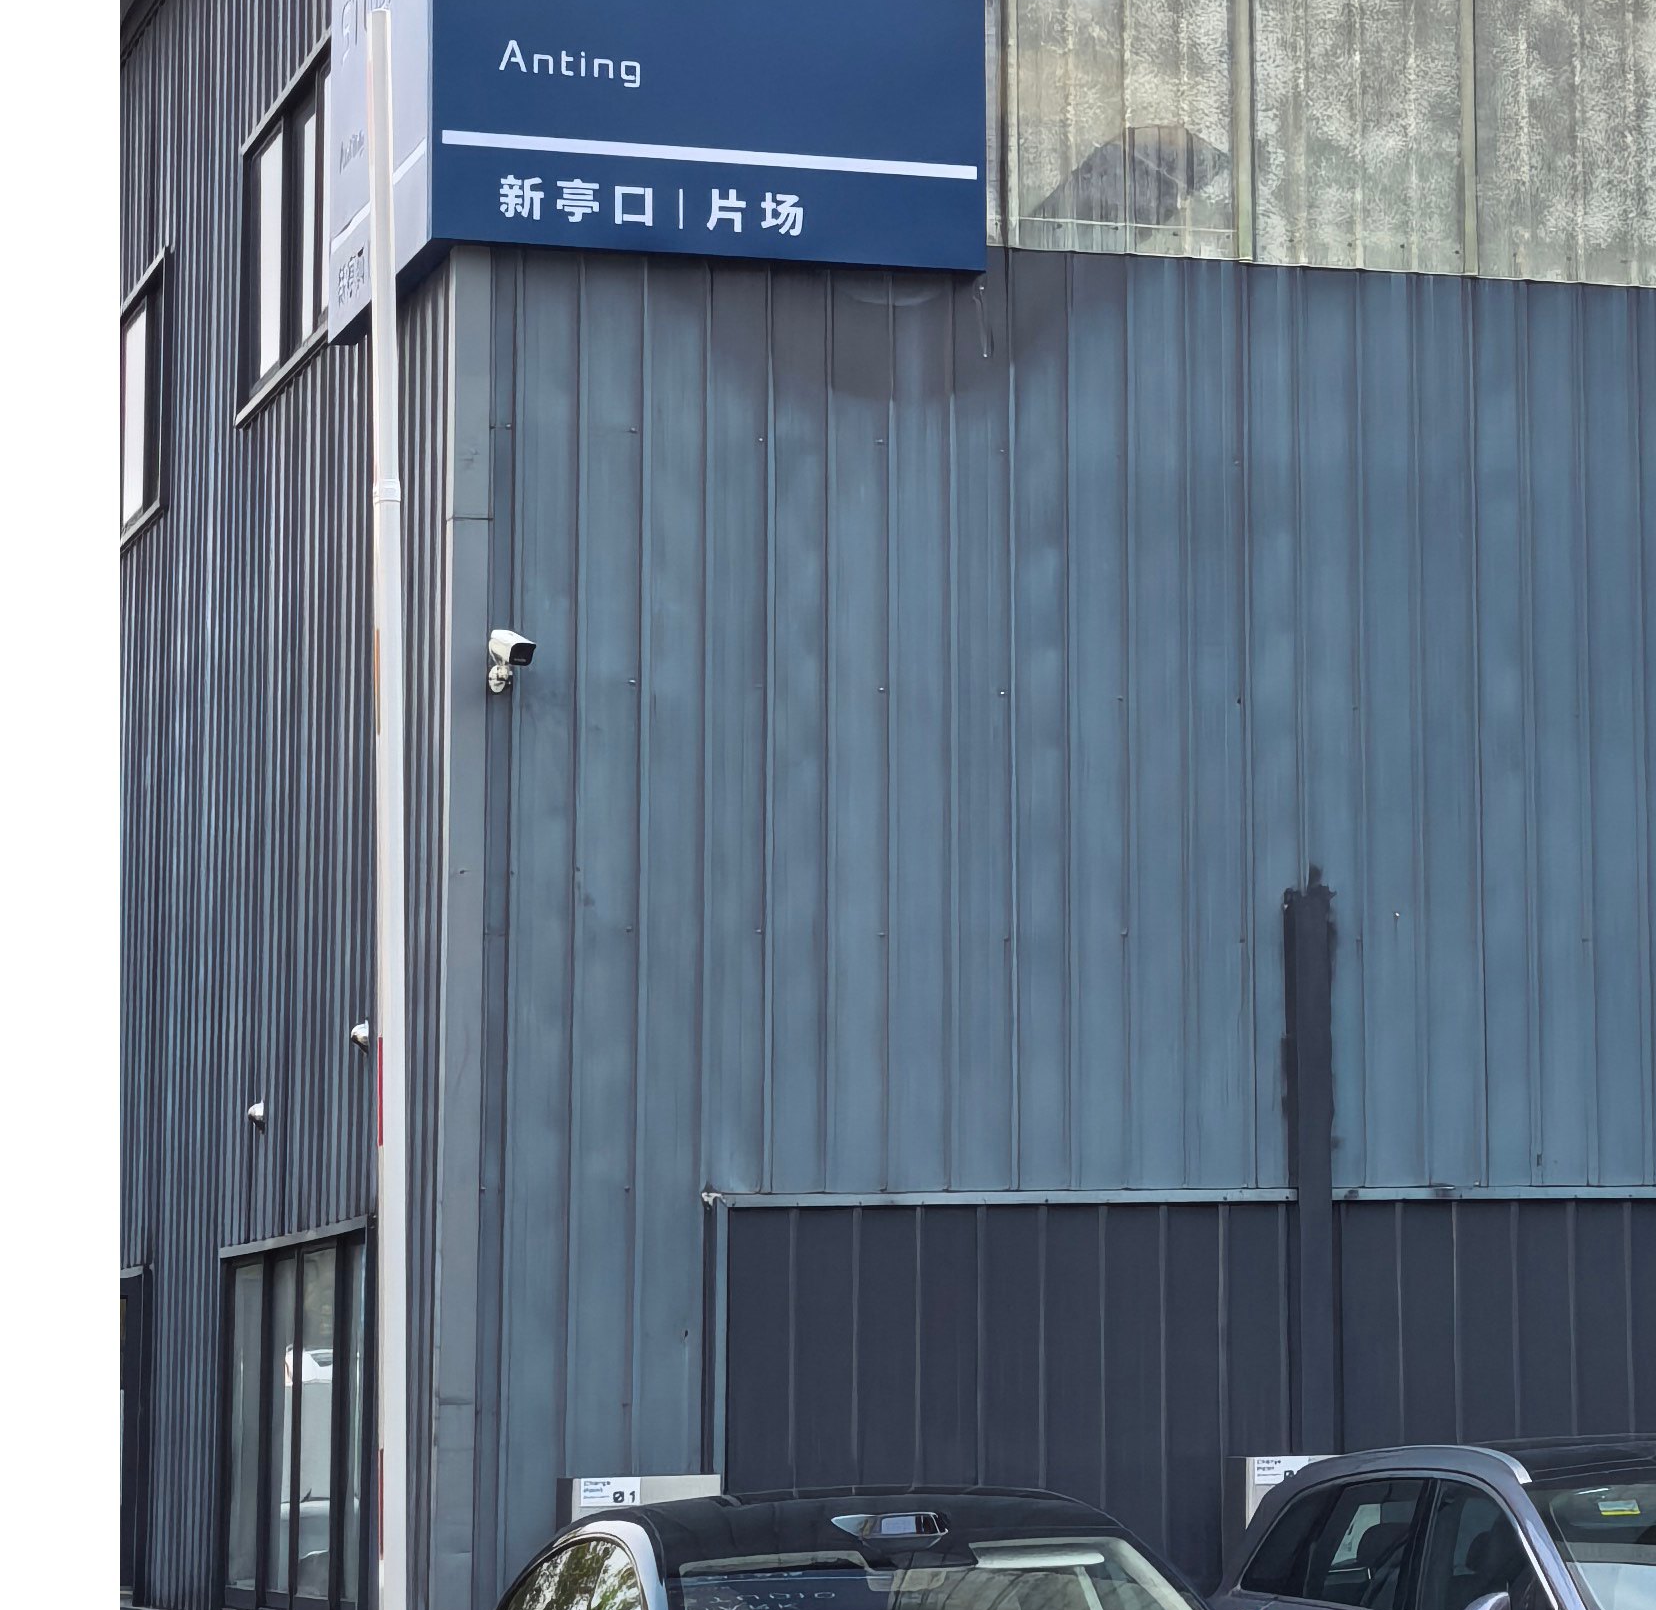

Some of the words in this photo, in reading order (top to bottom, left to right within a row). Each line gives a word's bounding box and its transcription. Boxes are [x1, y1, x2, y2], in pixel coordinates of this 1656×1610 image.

[499, 39, 641, 88] Anting
[499, 173, 654, 227] 新亭口
[706, 187, 805, 237] 片场
[612, 1490, 636, 1503] 01
